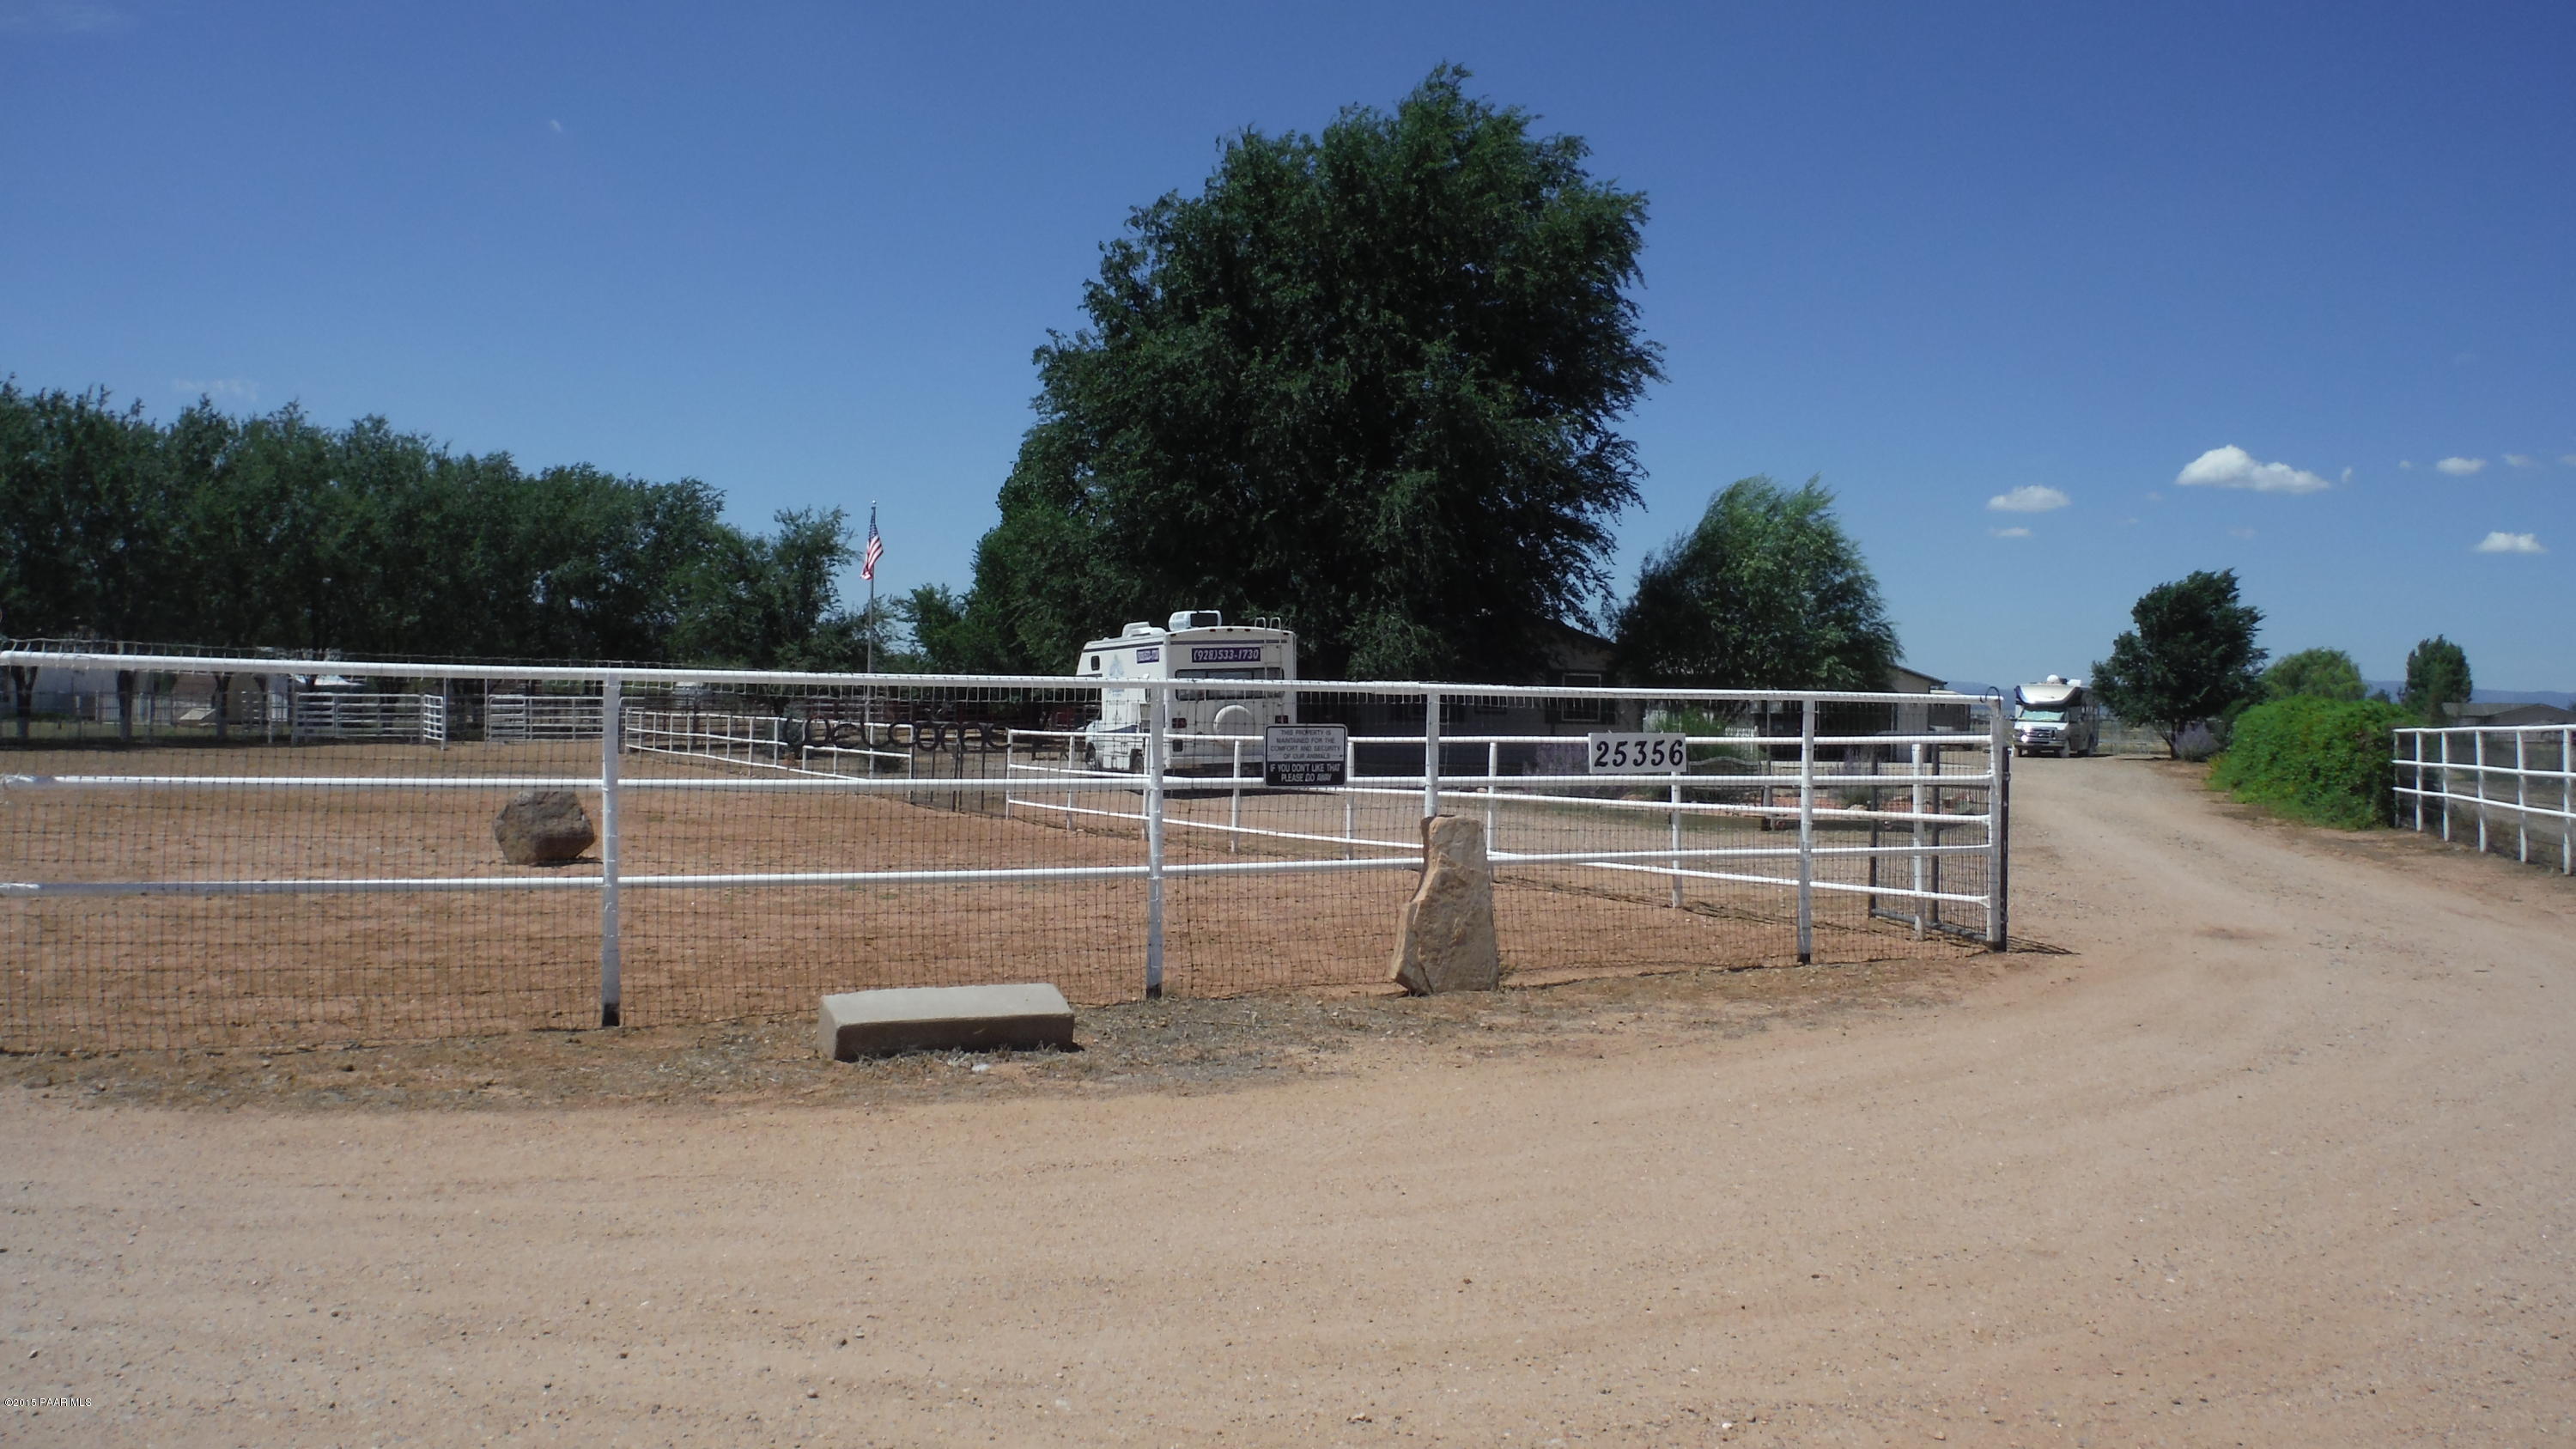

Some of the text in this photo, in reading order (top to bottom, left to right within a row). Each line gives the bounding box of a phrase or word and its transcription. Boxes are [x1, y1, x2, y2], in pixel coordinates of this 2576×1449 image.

[1194, 649, 1259, 661] (928)533-1730
[1595, 740, 1683, 767] 25356
[1270, 764, 1341, 772] IF YOU DON'T LIKE THAT
[1280, 773, 1333, 782] PLEASE GO AWAY
